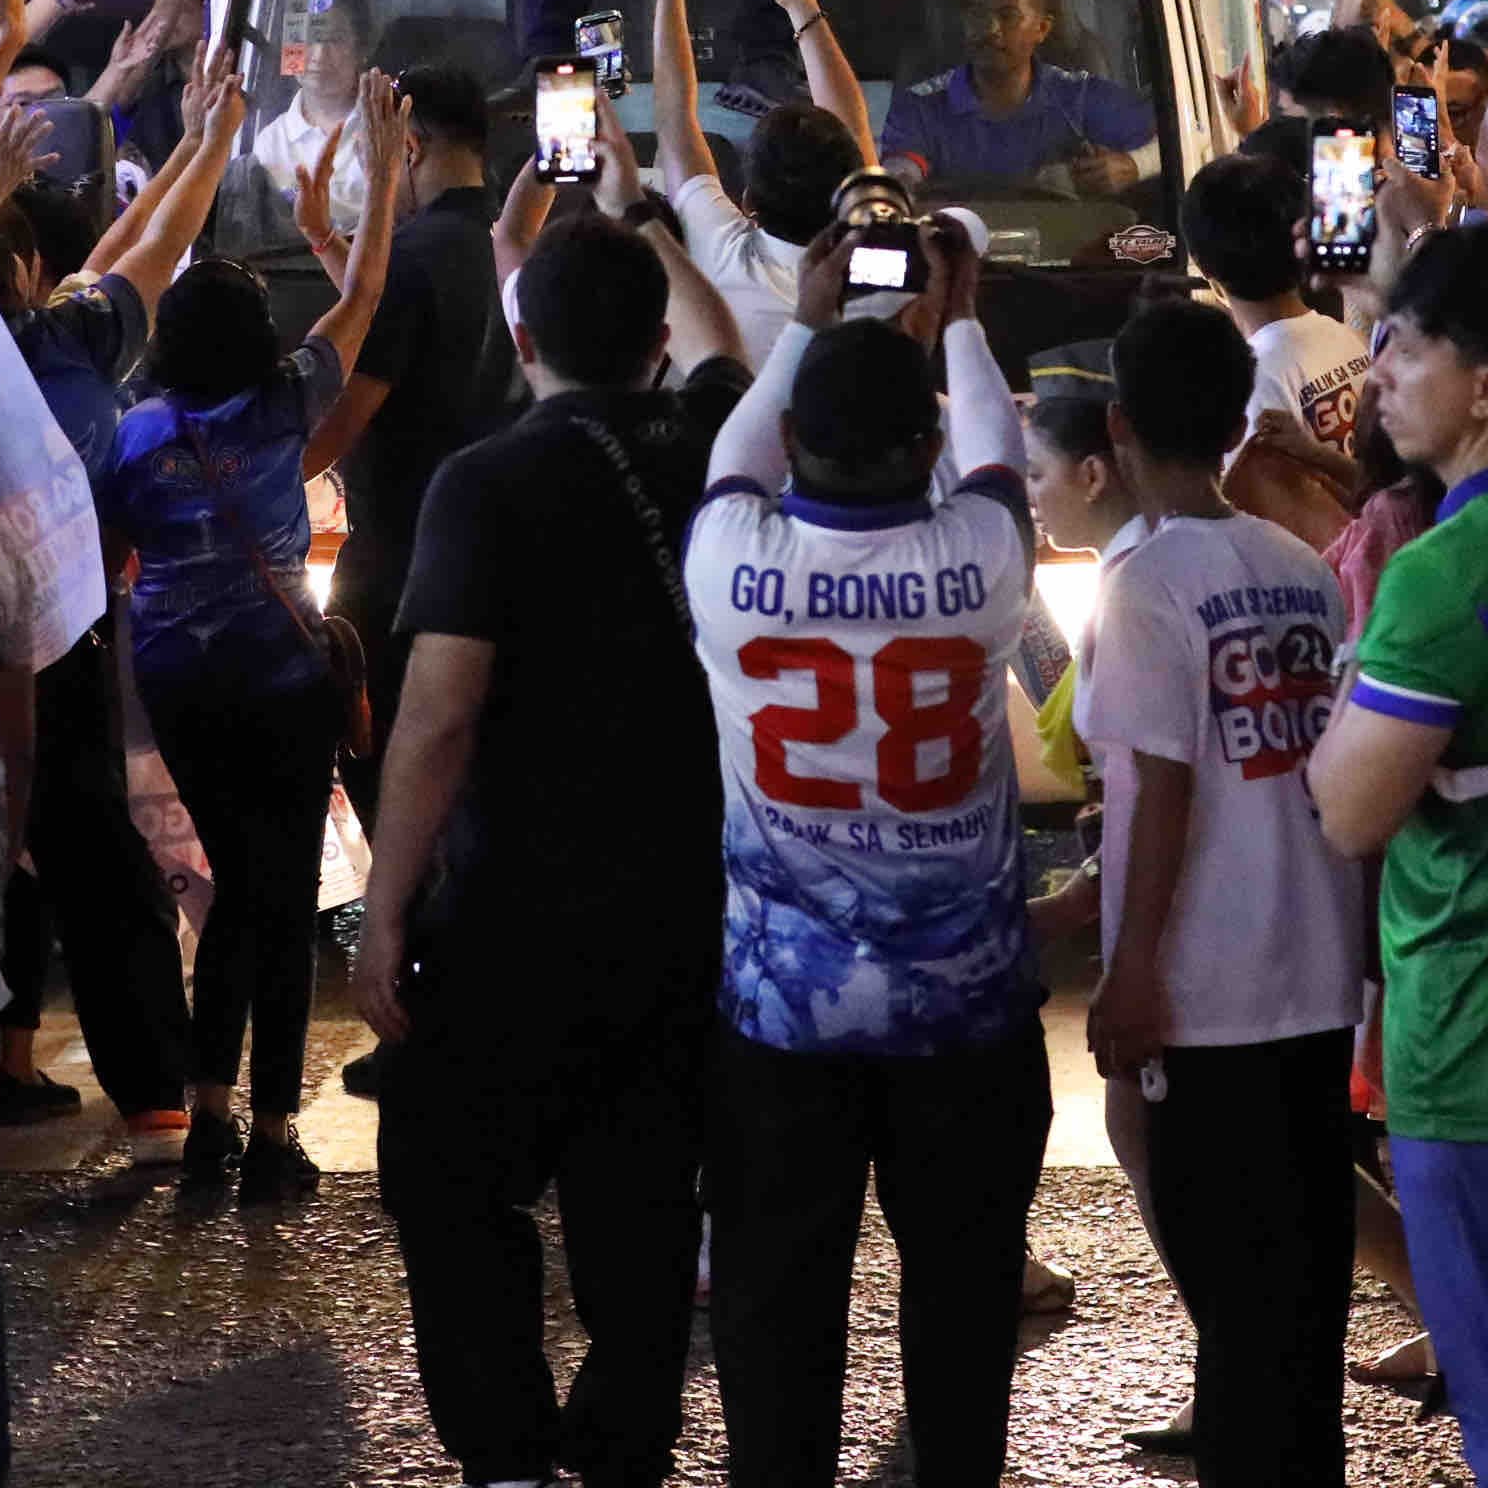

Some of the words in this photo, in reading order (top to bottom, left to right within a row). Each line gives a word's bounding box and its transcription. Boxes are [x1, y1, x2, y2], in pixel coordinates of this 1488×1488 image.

[1333, 365, 1350, 383] SA
[731, 563, 794, 624] GO,
[807, 571, 926, 621] BONG
[935, 562, 987, 617] GO
[737, 635, 989, 814] 28
[847, 823, 884, 854] SA
